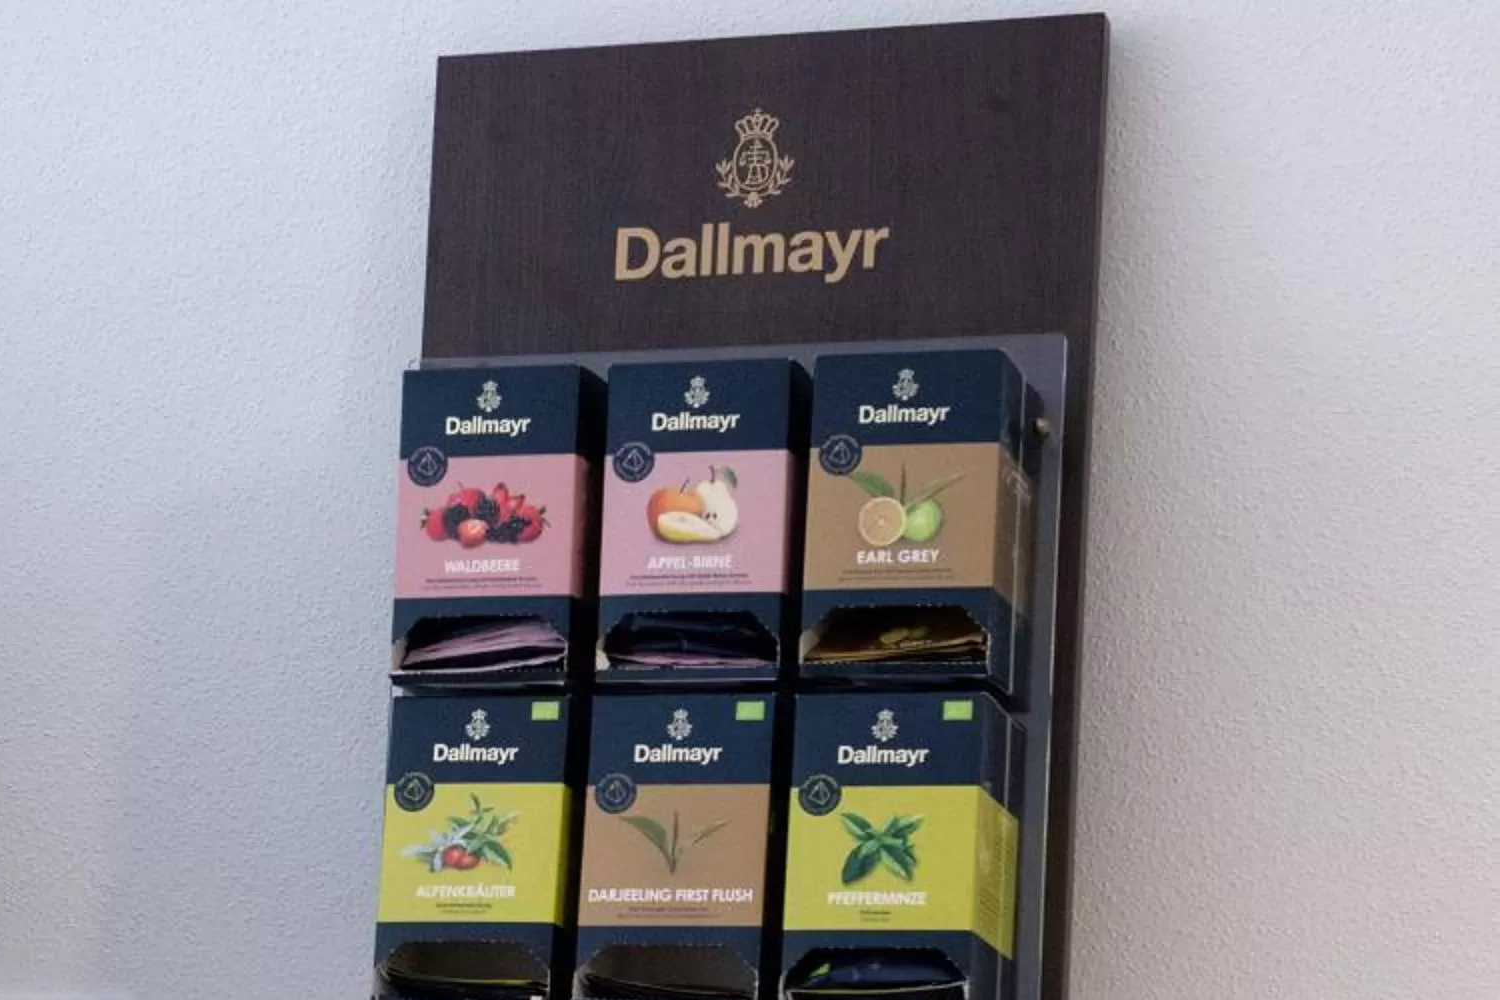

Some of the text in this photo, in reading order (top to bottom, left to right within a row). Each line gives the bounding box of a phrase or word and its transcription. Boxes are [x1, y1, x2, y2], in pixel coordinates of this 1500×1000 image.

[615, 221, 890, 284] Dallmayr
[651, 412, 740, 433] Dallmayr
[858, 404, 950, 426] Dallmayr
[445, 416, 531, 437] Dallmayr
[444, 558, 521, 573] WALDBEERE
[647, 554, 733, 570] APFEL-BIRNE
[856, 548, 940, 564] EARL GREY
[433, 743, 519, 765] Dallmayr
[633, 744, 723, 765] Dallmayr
[837, 746, 930, 767] Dallmayr
[416, 882, 517, 897] ALPENKRÄUTER
[588, 887, 754, 902] DARJEELING FIRST FLUSH
[827, 891, 928, 905] PFEFFERMINZE
